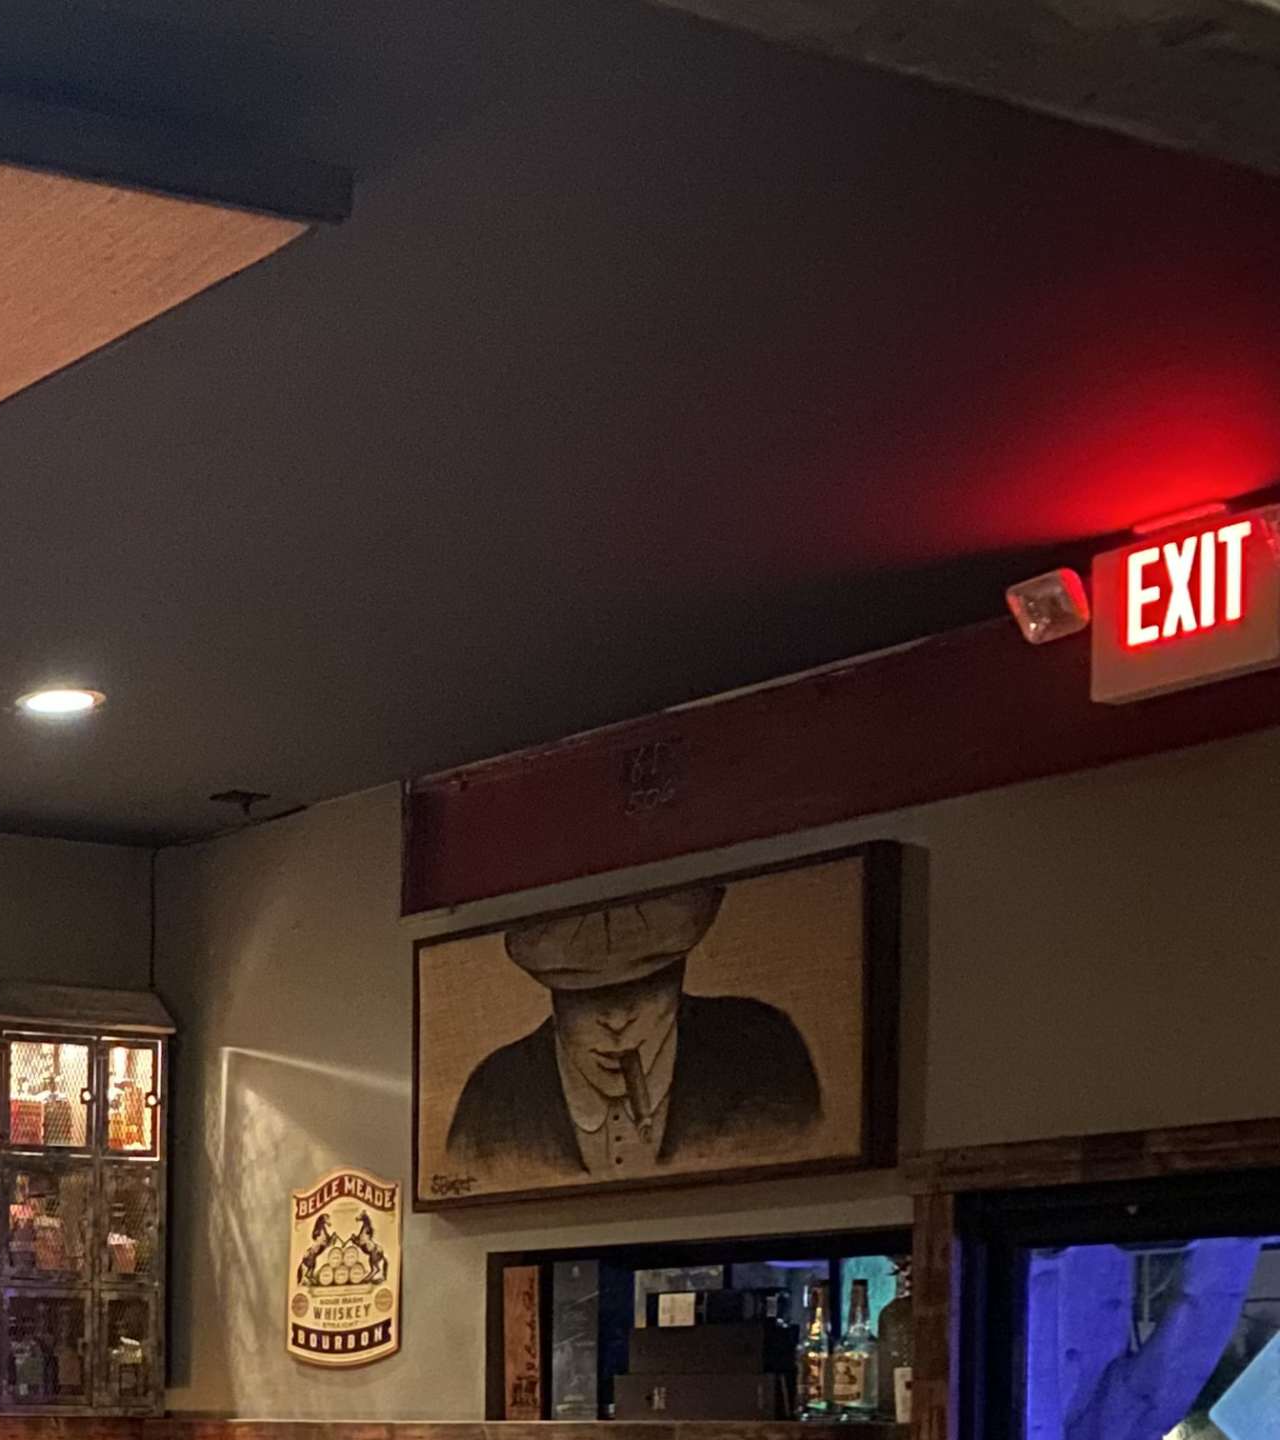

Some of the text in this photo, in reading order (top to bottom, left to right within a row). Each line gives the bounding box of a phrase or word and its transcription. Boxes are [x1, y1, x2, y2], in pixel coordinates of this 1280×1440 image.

[1127, 521, 1252, 647] EXIT
[298, 1178, 340, 1217] BELLE
[344, 1175, 393, 1208] MEADE
[313, 1303, 372, 1321] WHISKEY
[297, 1325, 383, 1350] BOURBON
